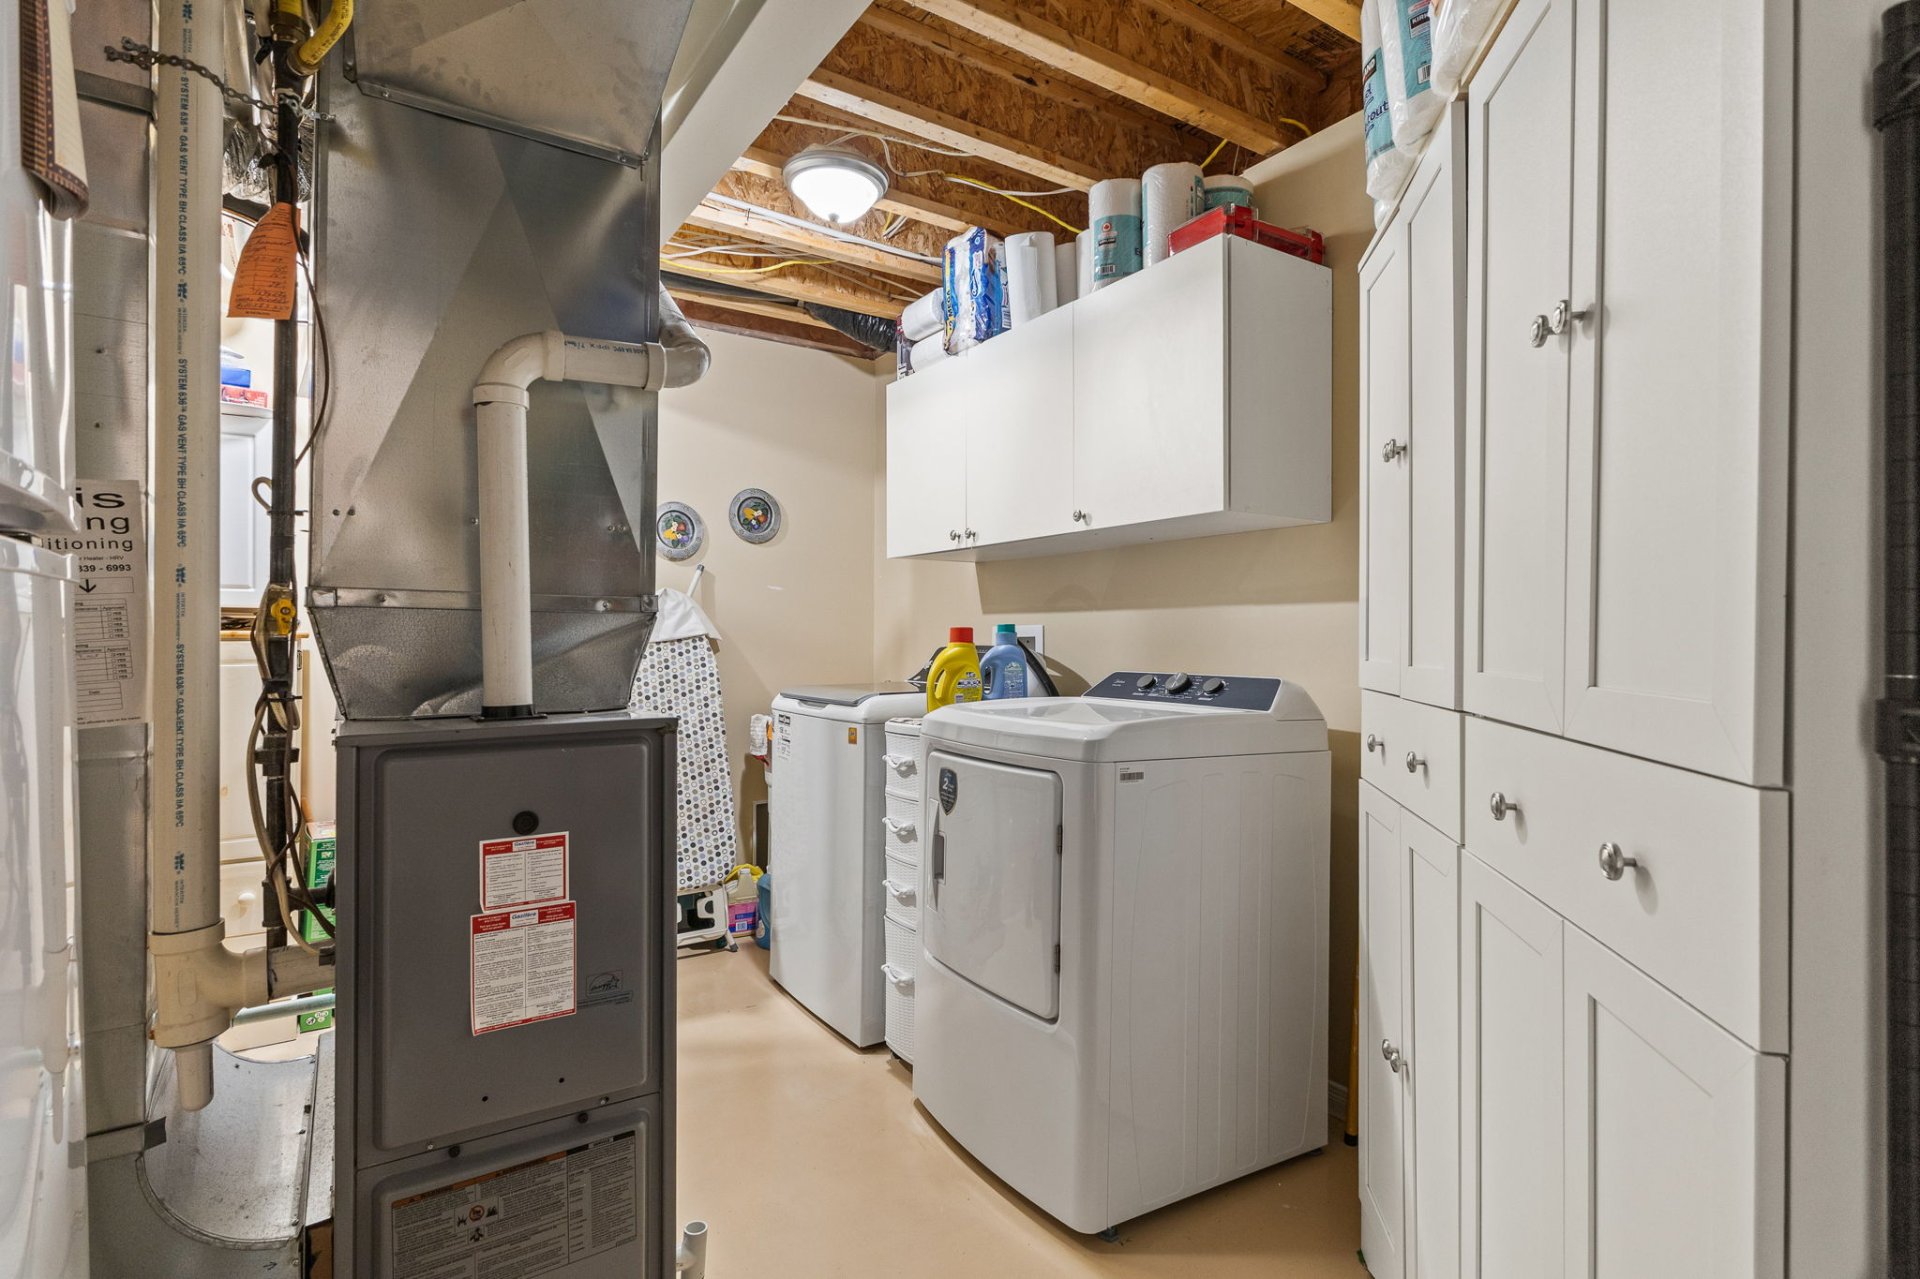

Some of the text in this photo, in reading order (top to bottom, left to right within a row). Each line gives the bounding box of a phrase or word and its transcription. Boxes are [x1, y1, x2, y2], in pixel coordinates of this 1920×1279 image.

[181, 77, 189, 110] SYSTEM
[180, 135, 188, 152] GAS
[180, 155, 188, 176] VENT
[179, 178, 188, 198] TYPE
[179, 201, 188, 213] BH
[179, 215, 187, 242] CLASS
[178, 359, 188, 390] SYSTEM
[178, 414, 187, 432] GAS
[178, 434, 187, 454] VENT
[177, 456, 187, 476] TYPE
[177, 478, 187, 489] BH
[177, 491, 187, 517] CLASS
[42, 538, 133, 551] itioning
[106, 563, 131, 572] 6993
[176, 644, 184, 674] SYSTEM
[176, 698, 184, 714] GAS
[176, 715, 184, 735] VENT
[176, 738, 184, 757] TYPE
[176, 759, 184, 770] BH
[176, 771, 184, 798] CLASS
[942, 777, 949, 790] 2
